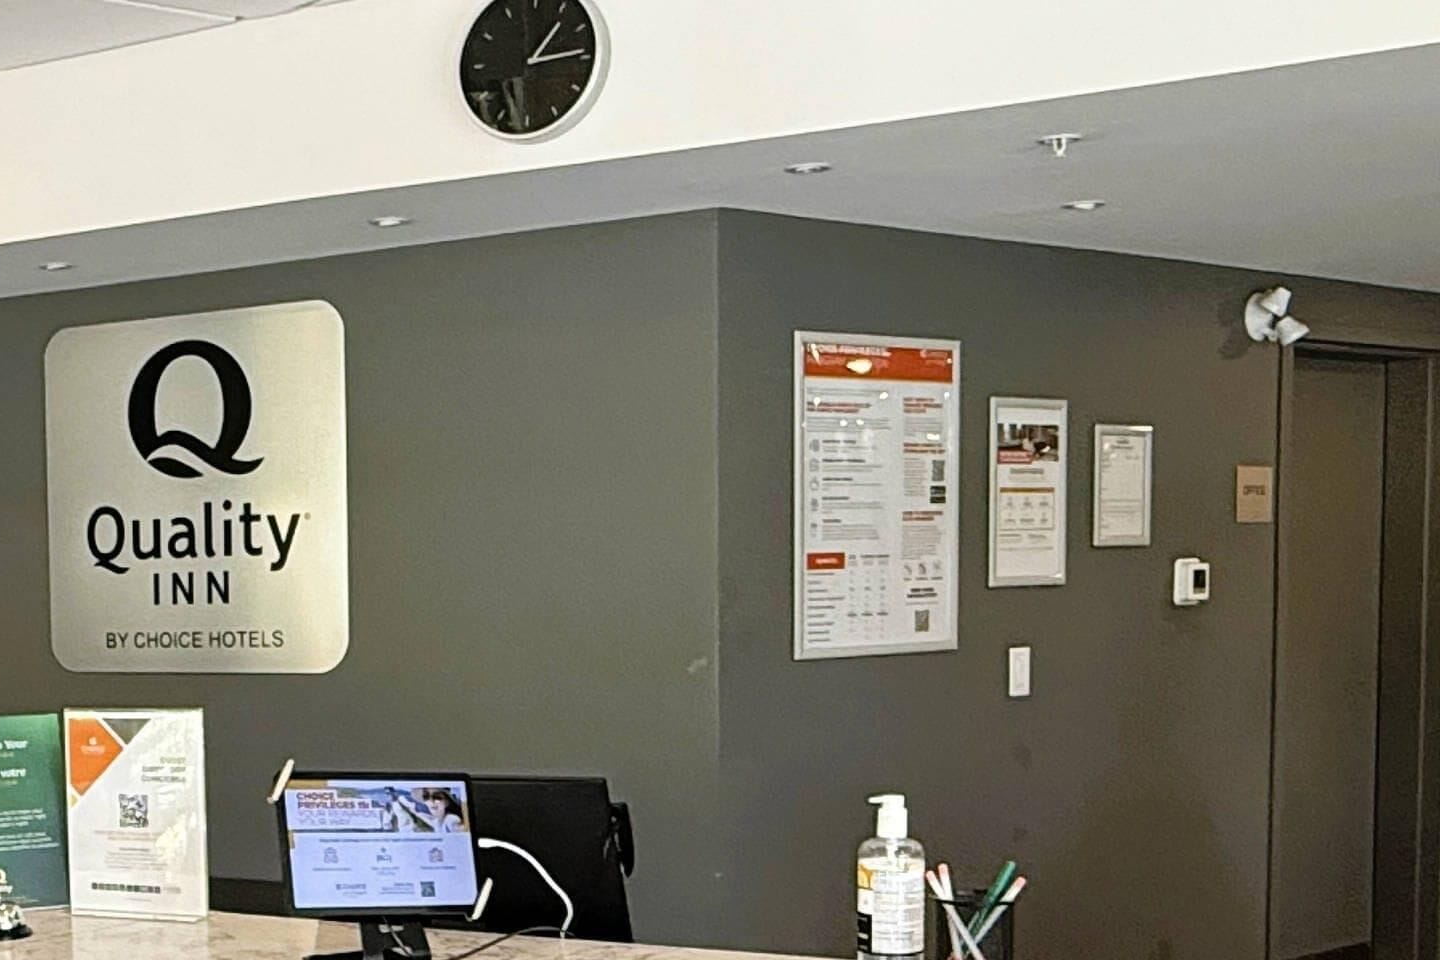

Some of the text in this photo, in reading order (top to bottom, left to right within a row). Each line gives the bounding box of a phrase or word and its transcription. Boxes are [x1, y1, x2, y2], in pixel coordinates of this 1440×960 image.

[128, 339, 265, 479] Q
[87, 500, 301, 574] Quality
[153, 570, 230, 605] INN
[106, 630, 285, 649] BY CHOICE HOTELS
[296, 791, 335, 801] CHOICE
